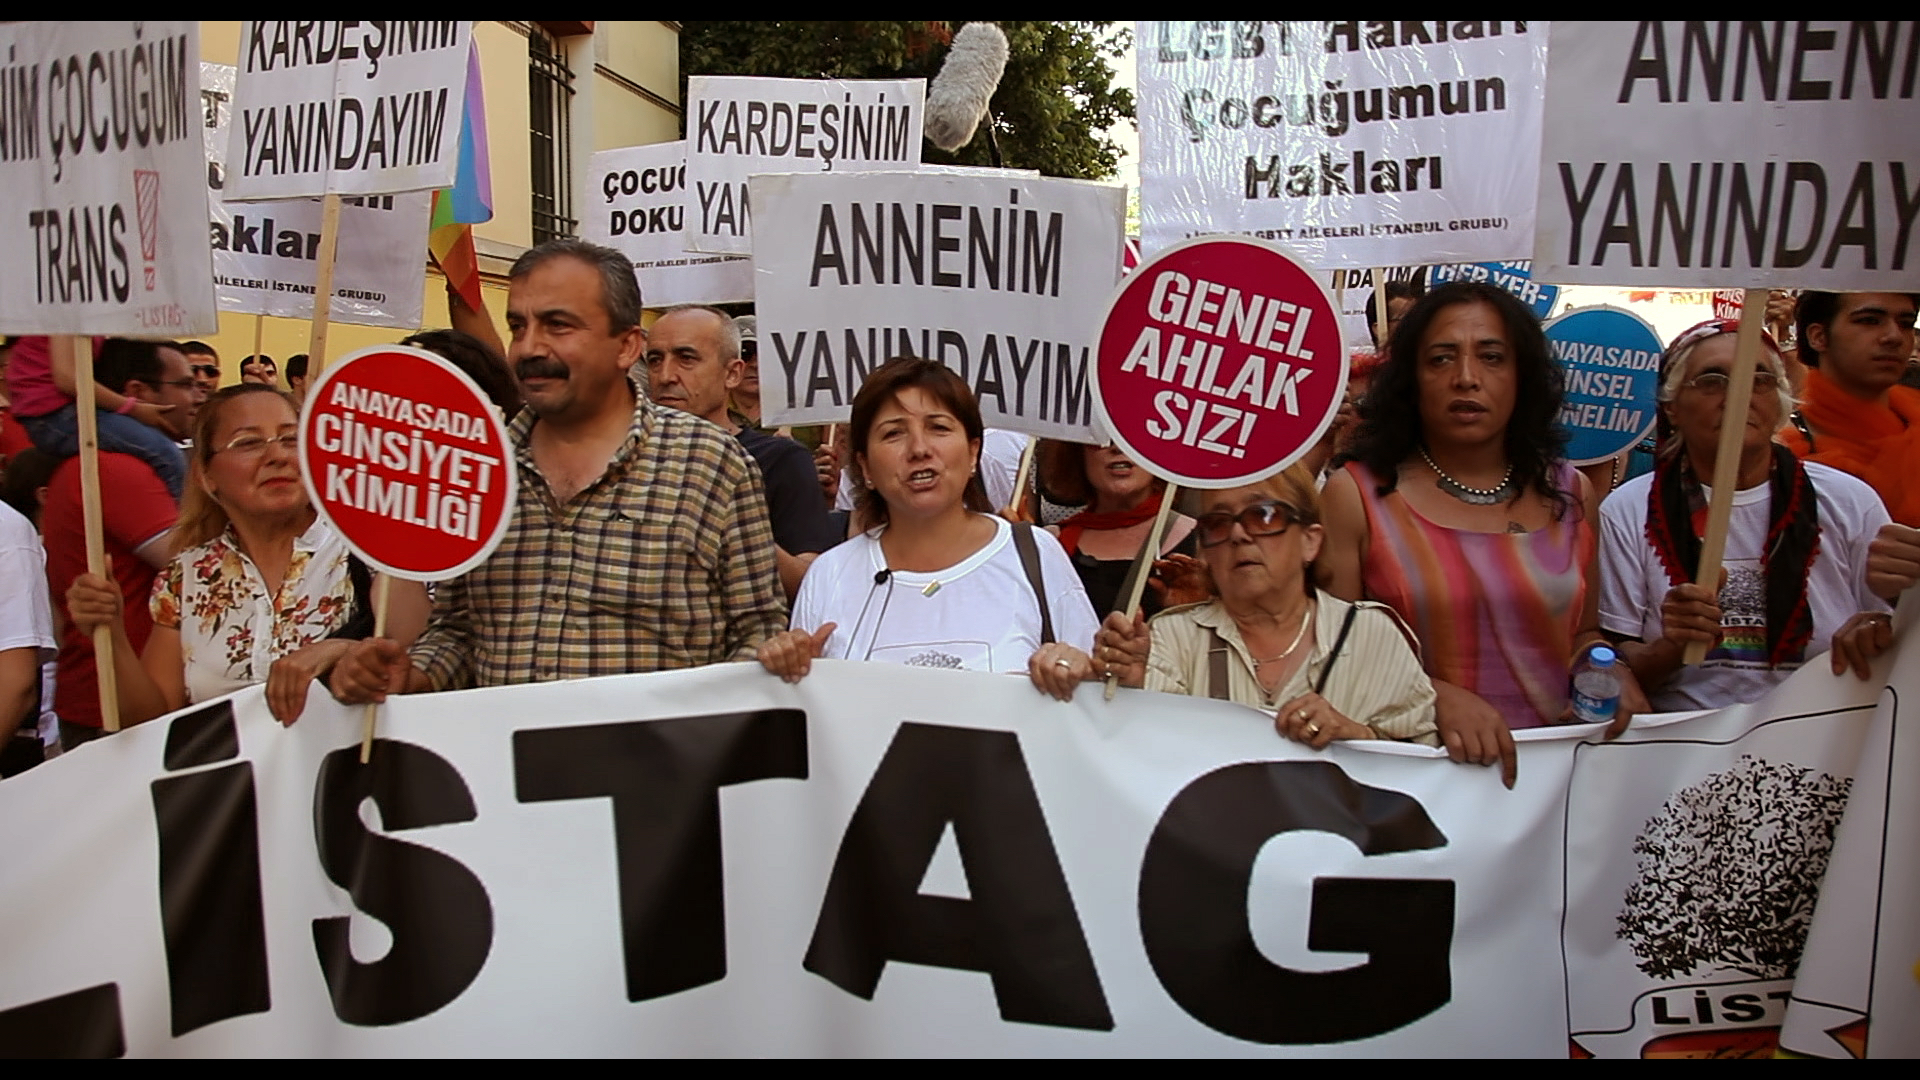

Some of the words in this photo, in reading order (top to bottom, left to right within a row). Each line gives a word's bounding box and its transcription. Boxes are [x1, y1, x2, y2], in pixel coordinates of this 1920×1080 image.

[48, 21, 188, 181] ÇOCUĞUM
[243, 87, 448, 177] YANINDAYIM
[697, 92, 910, 171] KARDEŞİNİM
[1181, 76, 1506, 143] Çocuğumun
[1245, 150, 1442, 200] Hakları
[29, 203, 130, 304] TRANS
[210, 214, 337, 262] aklar
[610, 205, 684, 236] DOKU
[810, 188, 1063, 297] ANNENİM
[1448, 217, 1509, 232] GRUBU)
[1558, 162, 1920, 270] YANINDAY
[338, 288, 386, 304] GRUBU)
[1148, 271, 1313, 361] GENEL
[1120, 326, 1313, 417] AHLAK
[314, 411, 501, 494] CİNSİYET
[330, 381, 489, 445] ANAYASADA
[1146, 390, 1258, 459] SIZ!
[325, 462, 483, 542] KİMLİĞİ
